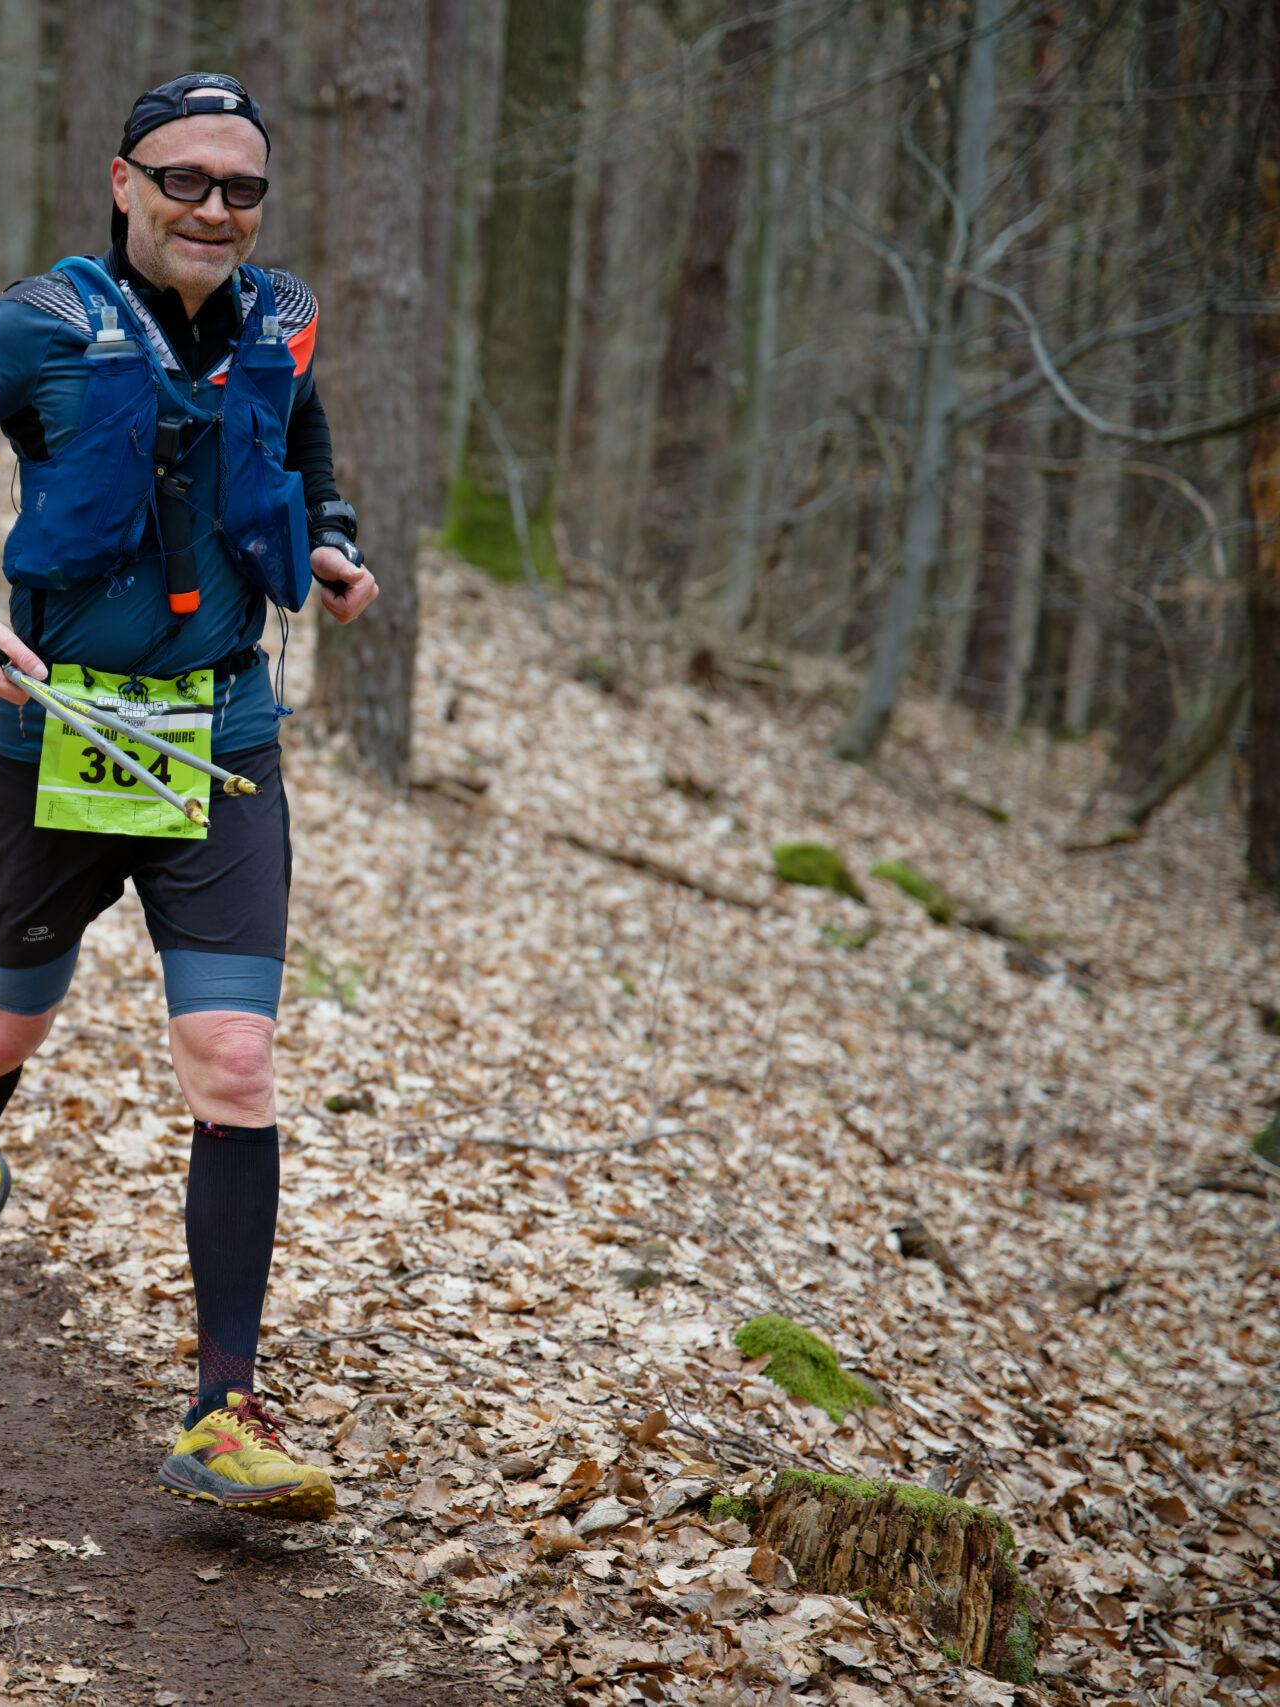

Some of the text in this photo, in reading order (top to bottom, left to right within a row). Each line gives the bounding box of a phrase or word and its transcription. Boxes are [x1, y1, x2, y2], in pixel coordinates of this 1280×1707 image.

[97, 696, 169, 711] ENDURANCE
[118, 708, 149, 718] SHOP
[79, 747, 172, 787] 364
